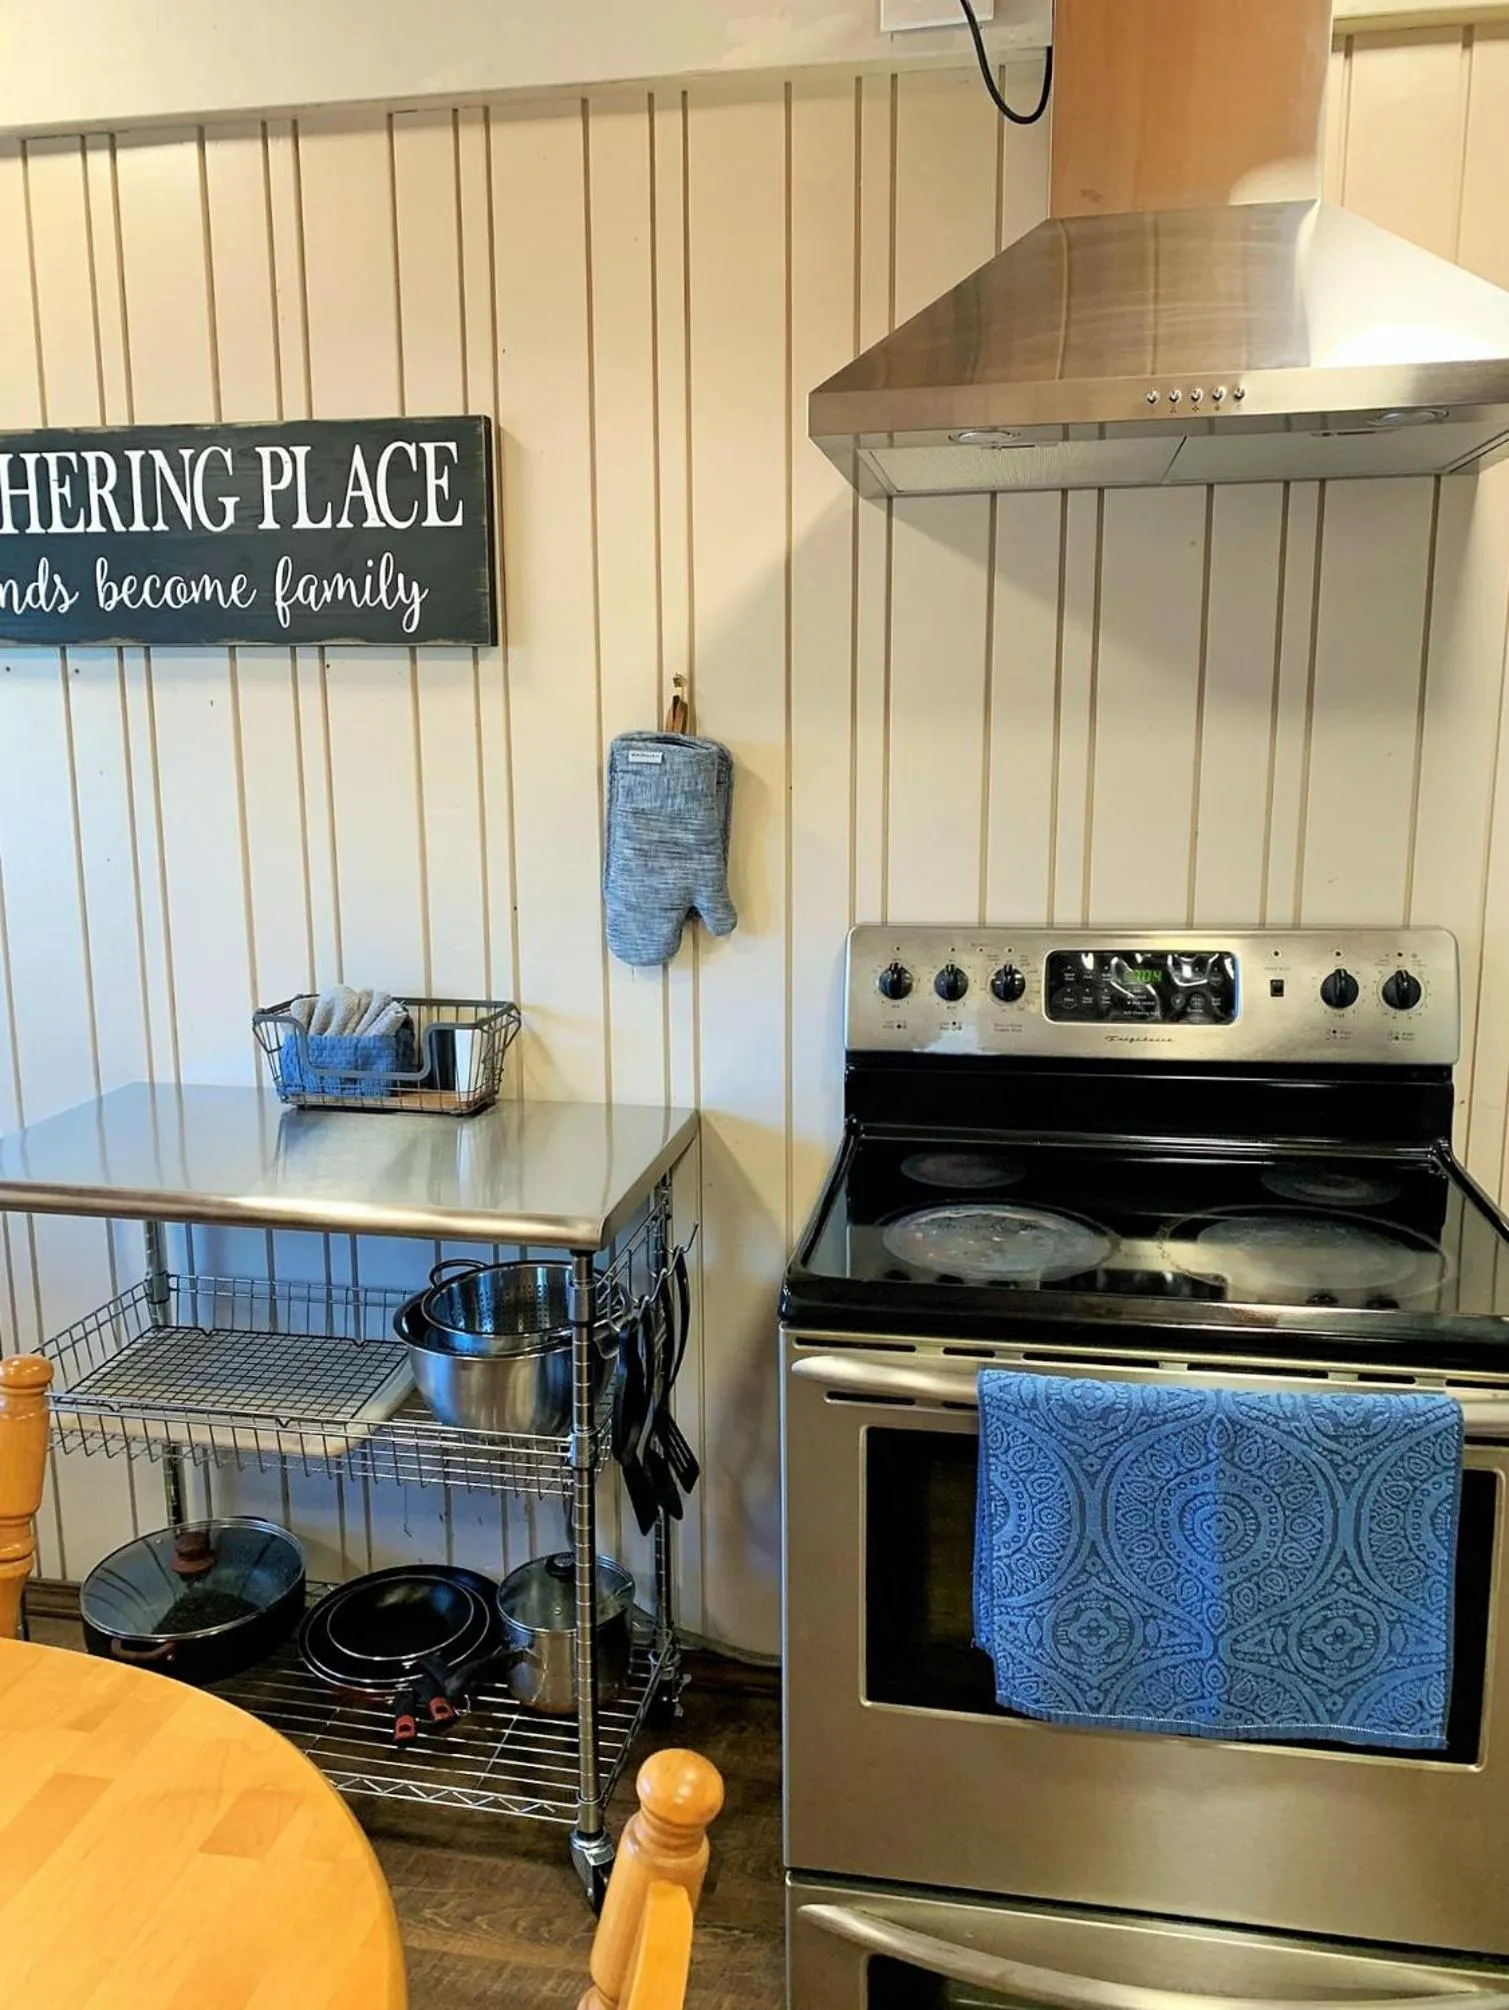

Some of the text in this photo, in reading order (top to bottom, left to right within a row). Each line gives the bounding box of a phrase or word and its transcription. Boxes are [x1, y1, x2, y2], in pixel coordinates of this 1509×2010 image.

[0, 441, 464, 535] HERING PLACE
[0, 552, 429, 634] nds become family
